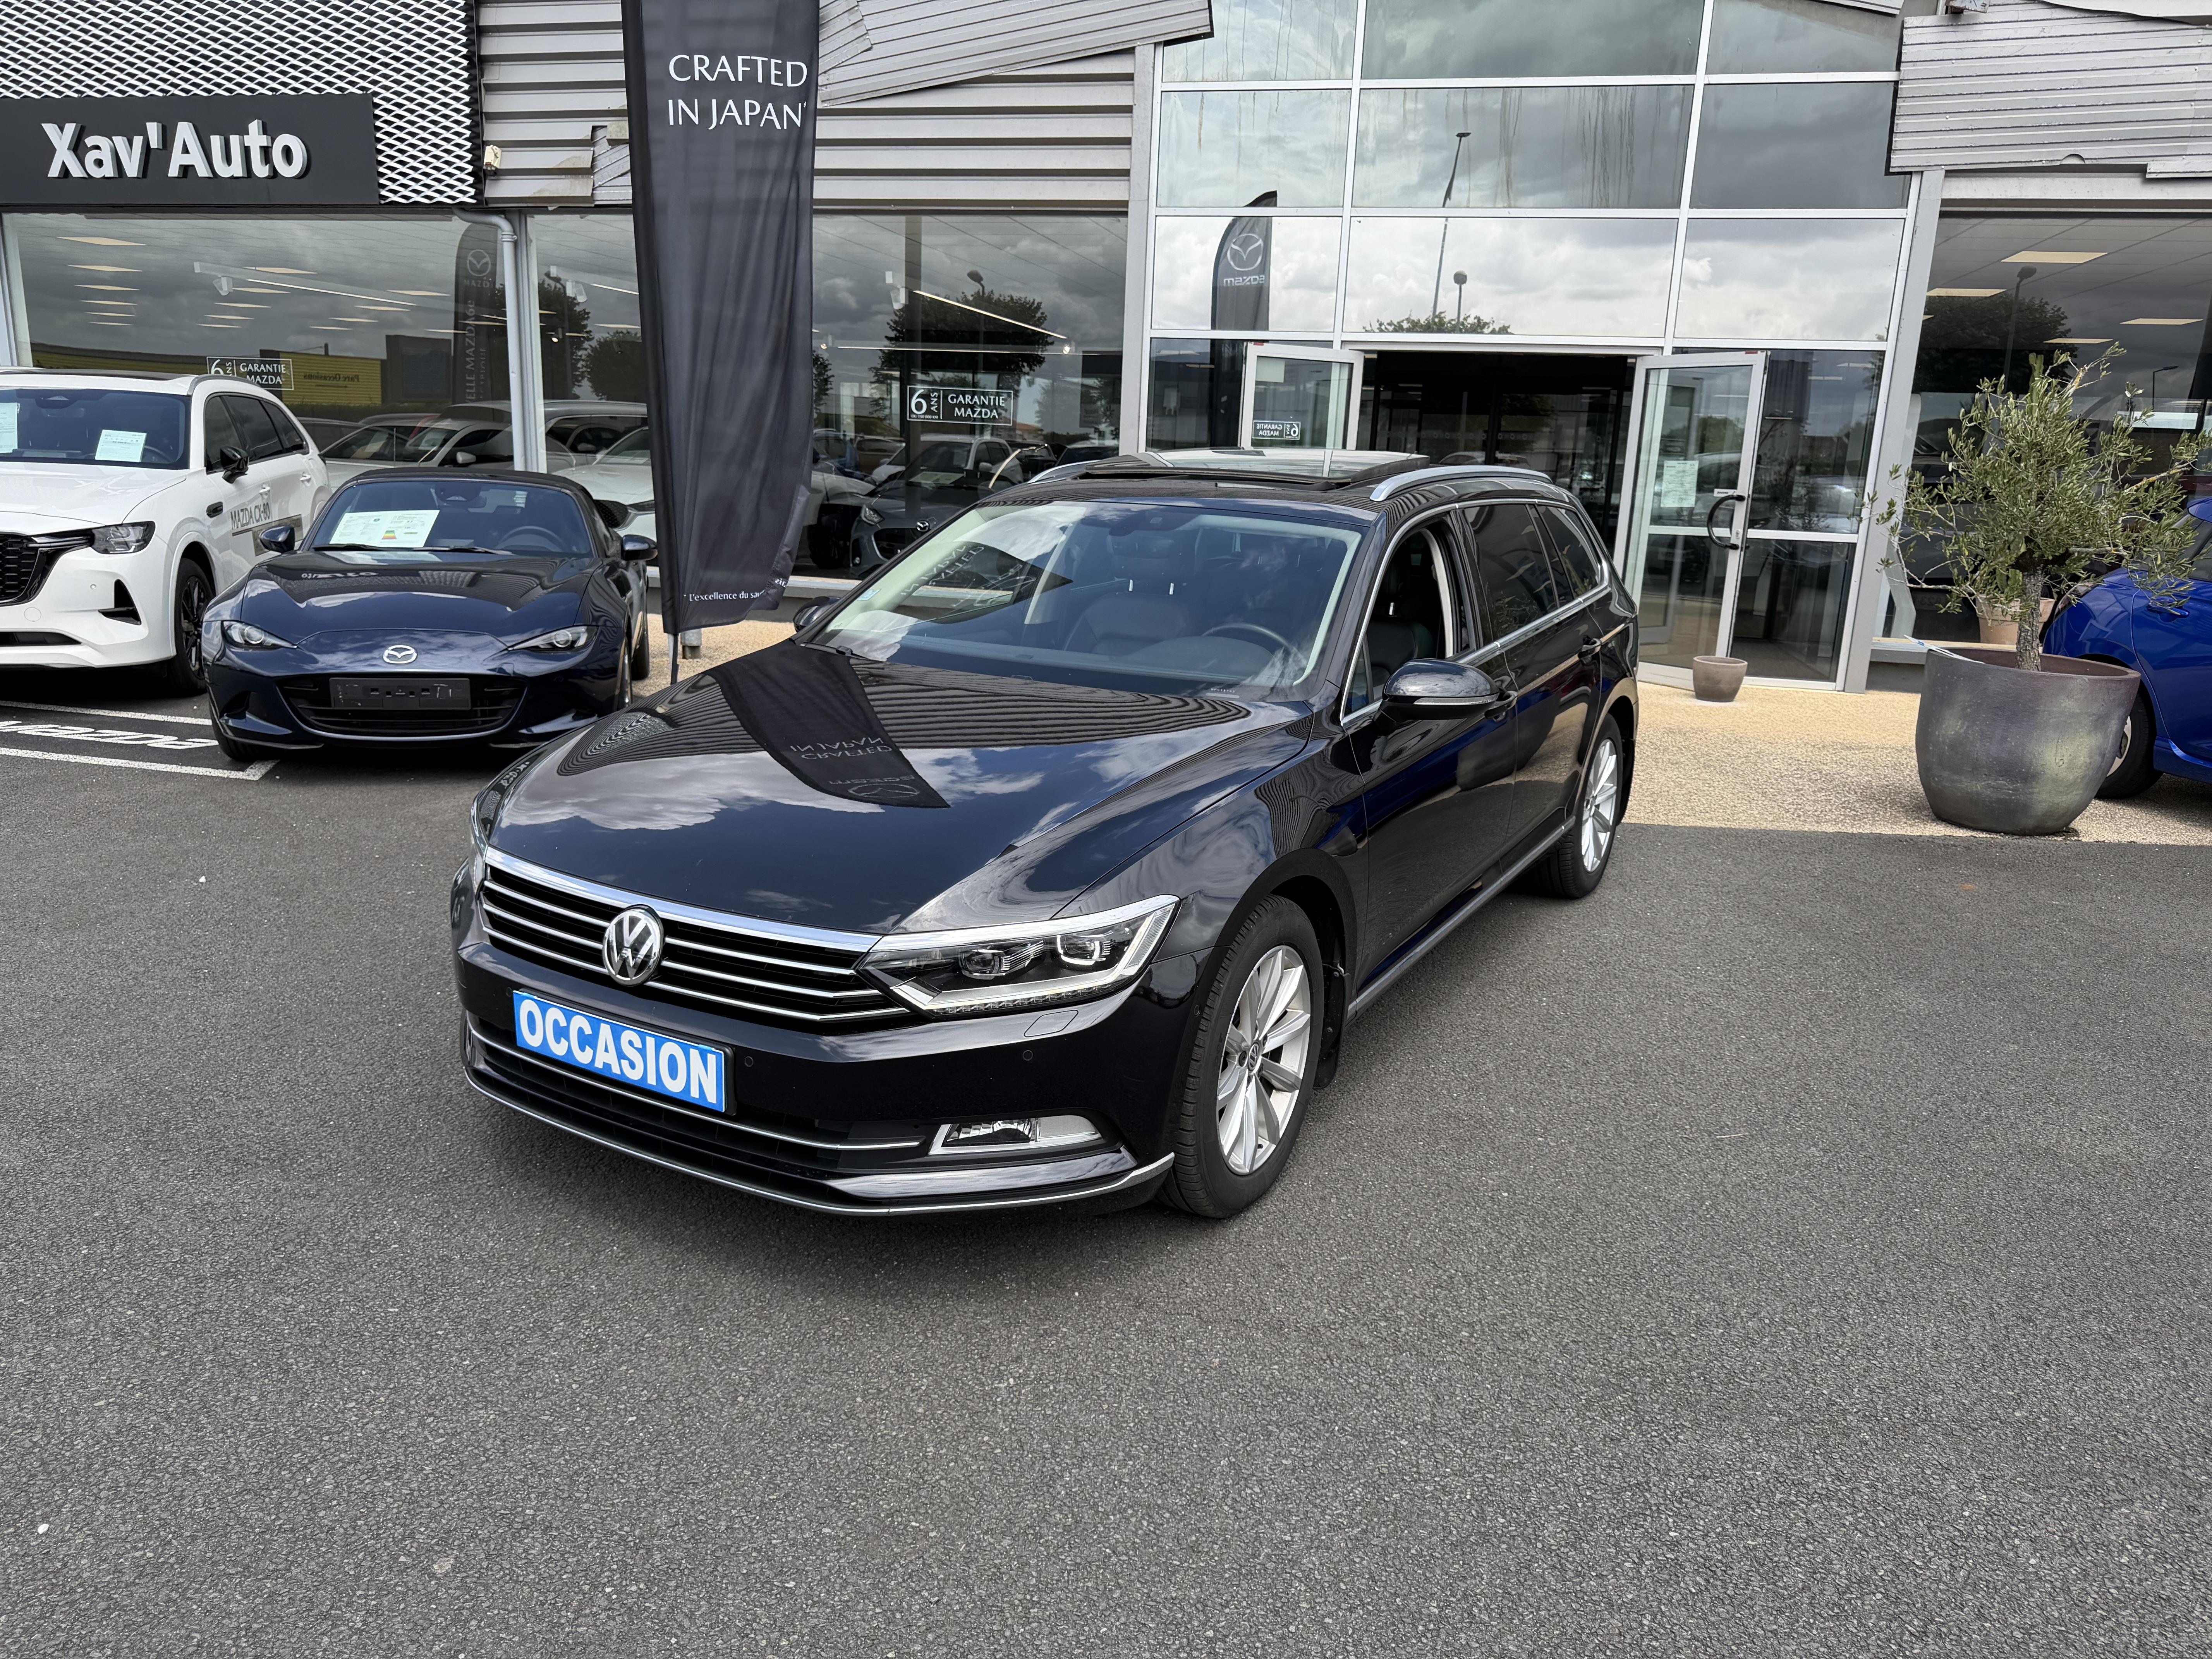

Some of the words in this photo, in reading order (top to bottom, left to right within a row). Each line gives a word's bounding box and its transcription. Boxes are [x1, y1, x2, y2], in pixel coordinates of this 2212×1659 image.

[669, 55, 807, 87] CRAFTED
[668, 99, 699, 125] IN
[41, 119, 307, 178] Xav'Auto
[240, 363, 286, 373] GARANTIE
[246, 375, 282, 384] MAZDA
[911, 389, 927, 415] 6
[948, 394, 1005, 406] GARANTIE
[954, 407, 998, 419] MAZDA
[230, 507, 254, 530] MAZDA
[254, 502, 270, 523] CX-80
[689, 592, 737, 602] L'excellence
[739, 591, 748, 599] du
[519, 1000, 718, 1104] OCCASION
